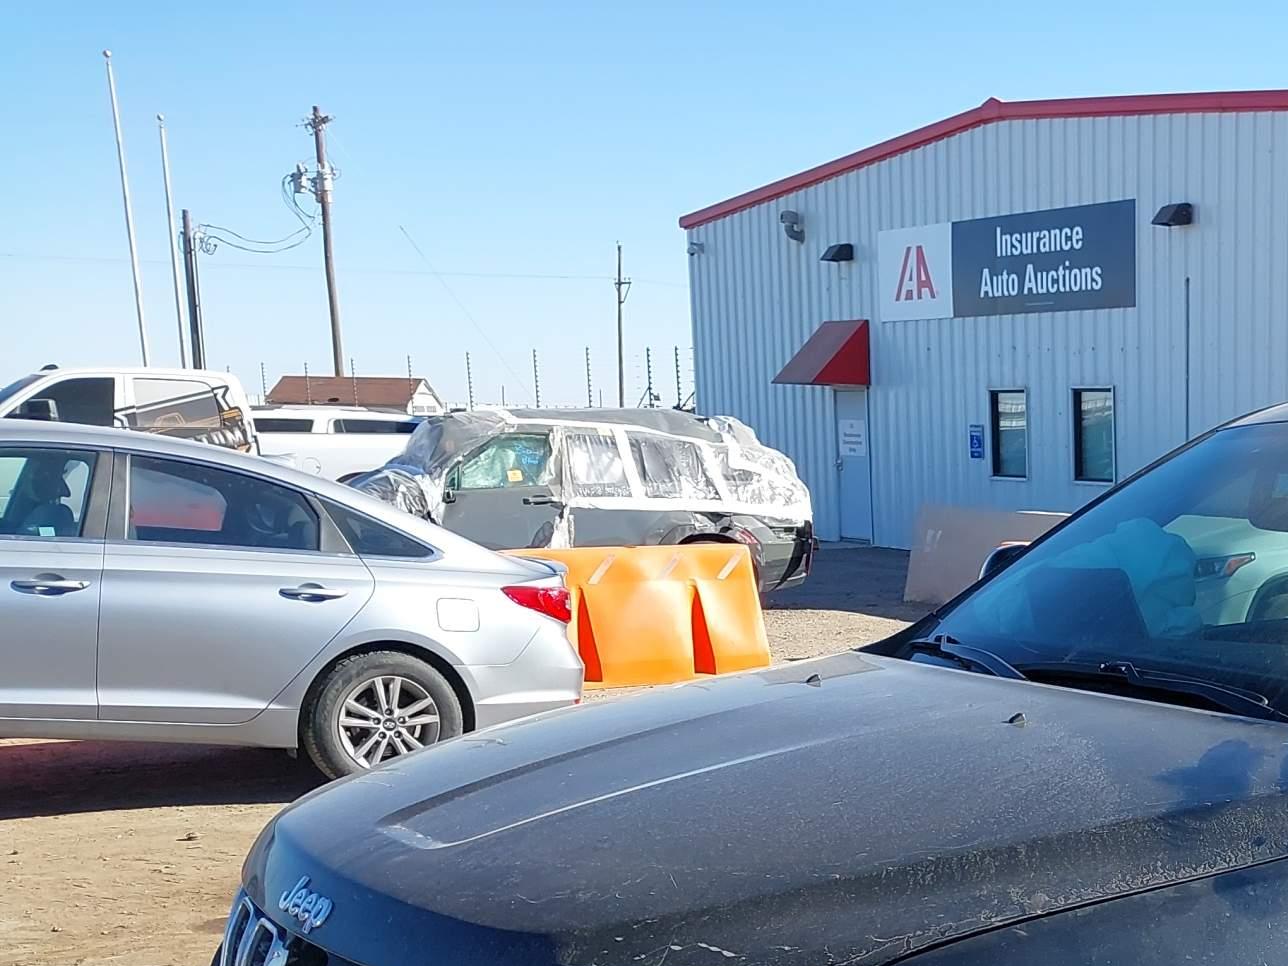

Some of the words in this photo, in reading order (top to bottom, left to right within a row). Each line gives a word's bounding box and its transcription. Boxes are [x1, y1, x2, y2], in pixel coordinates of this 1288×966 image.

[996, 224, 1083, 258] Insurance
[980, 267, 1019, 299] Auto
[1023, 260, 1102, 295] Auctions
[278, 875, 332, 935] Jeep
